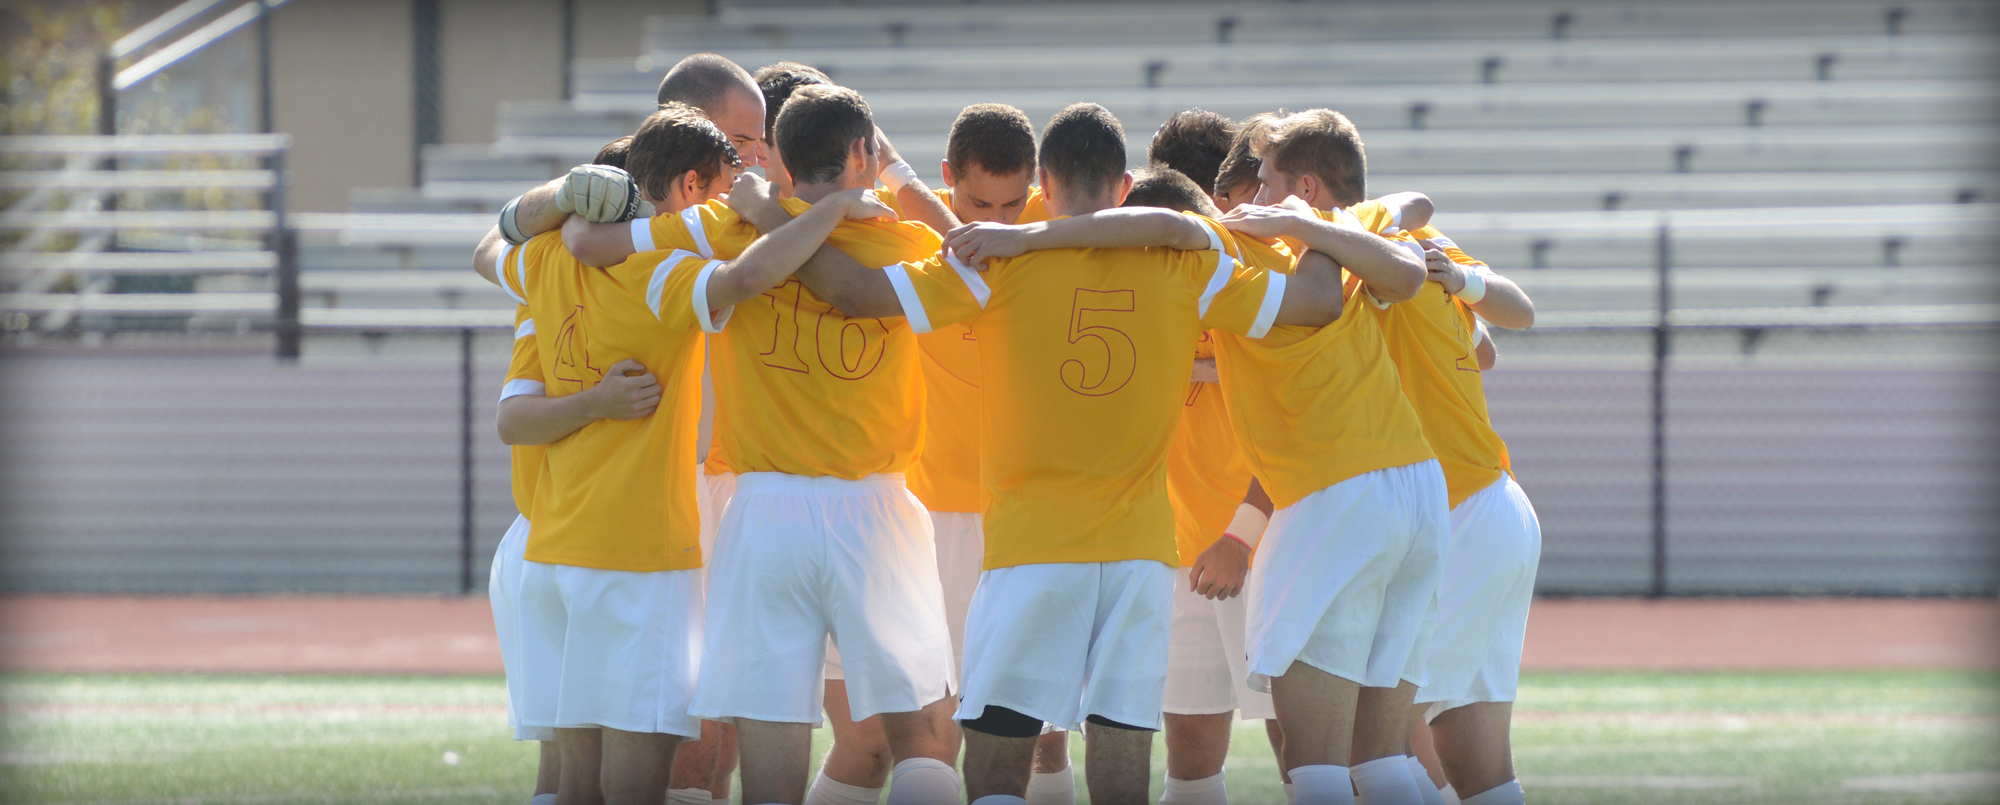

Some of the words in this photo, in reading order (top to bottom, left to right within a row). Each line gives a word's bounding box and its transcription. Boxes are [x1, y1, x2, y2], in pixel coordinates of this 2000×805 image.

[554, 304, 605, 391] 4
[759, 279, 889, 380] 16
[1060, 288, 1137, 397] 5
